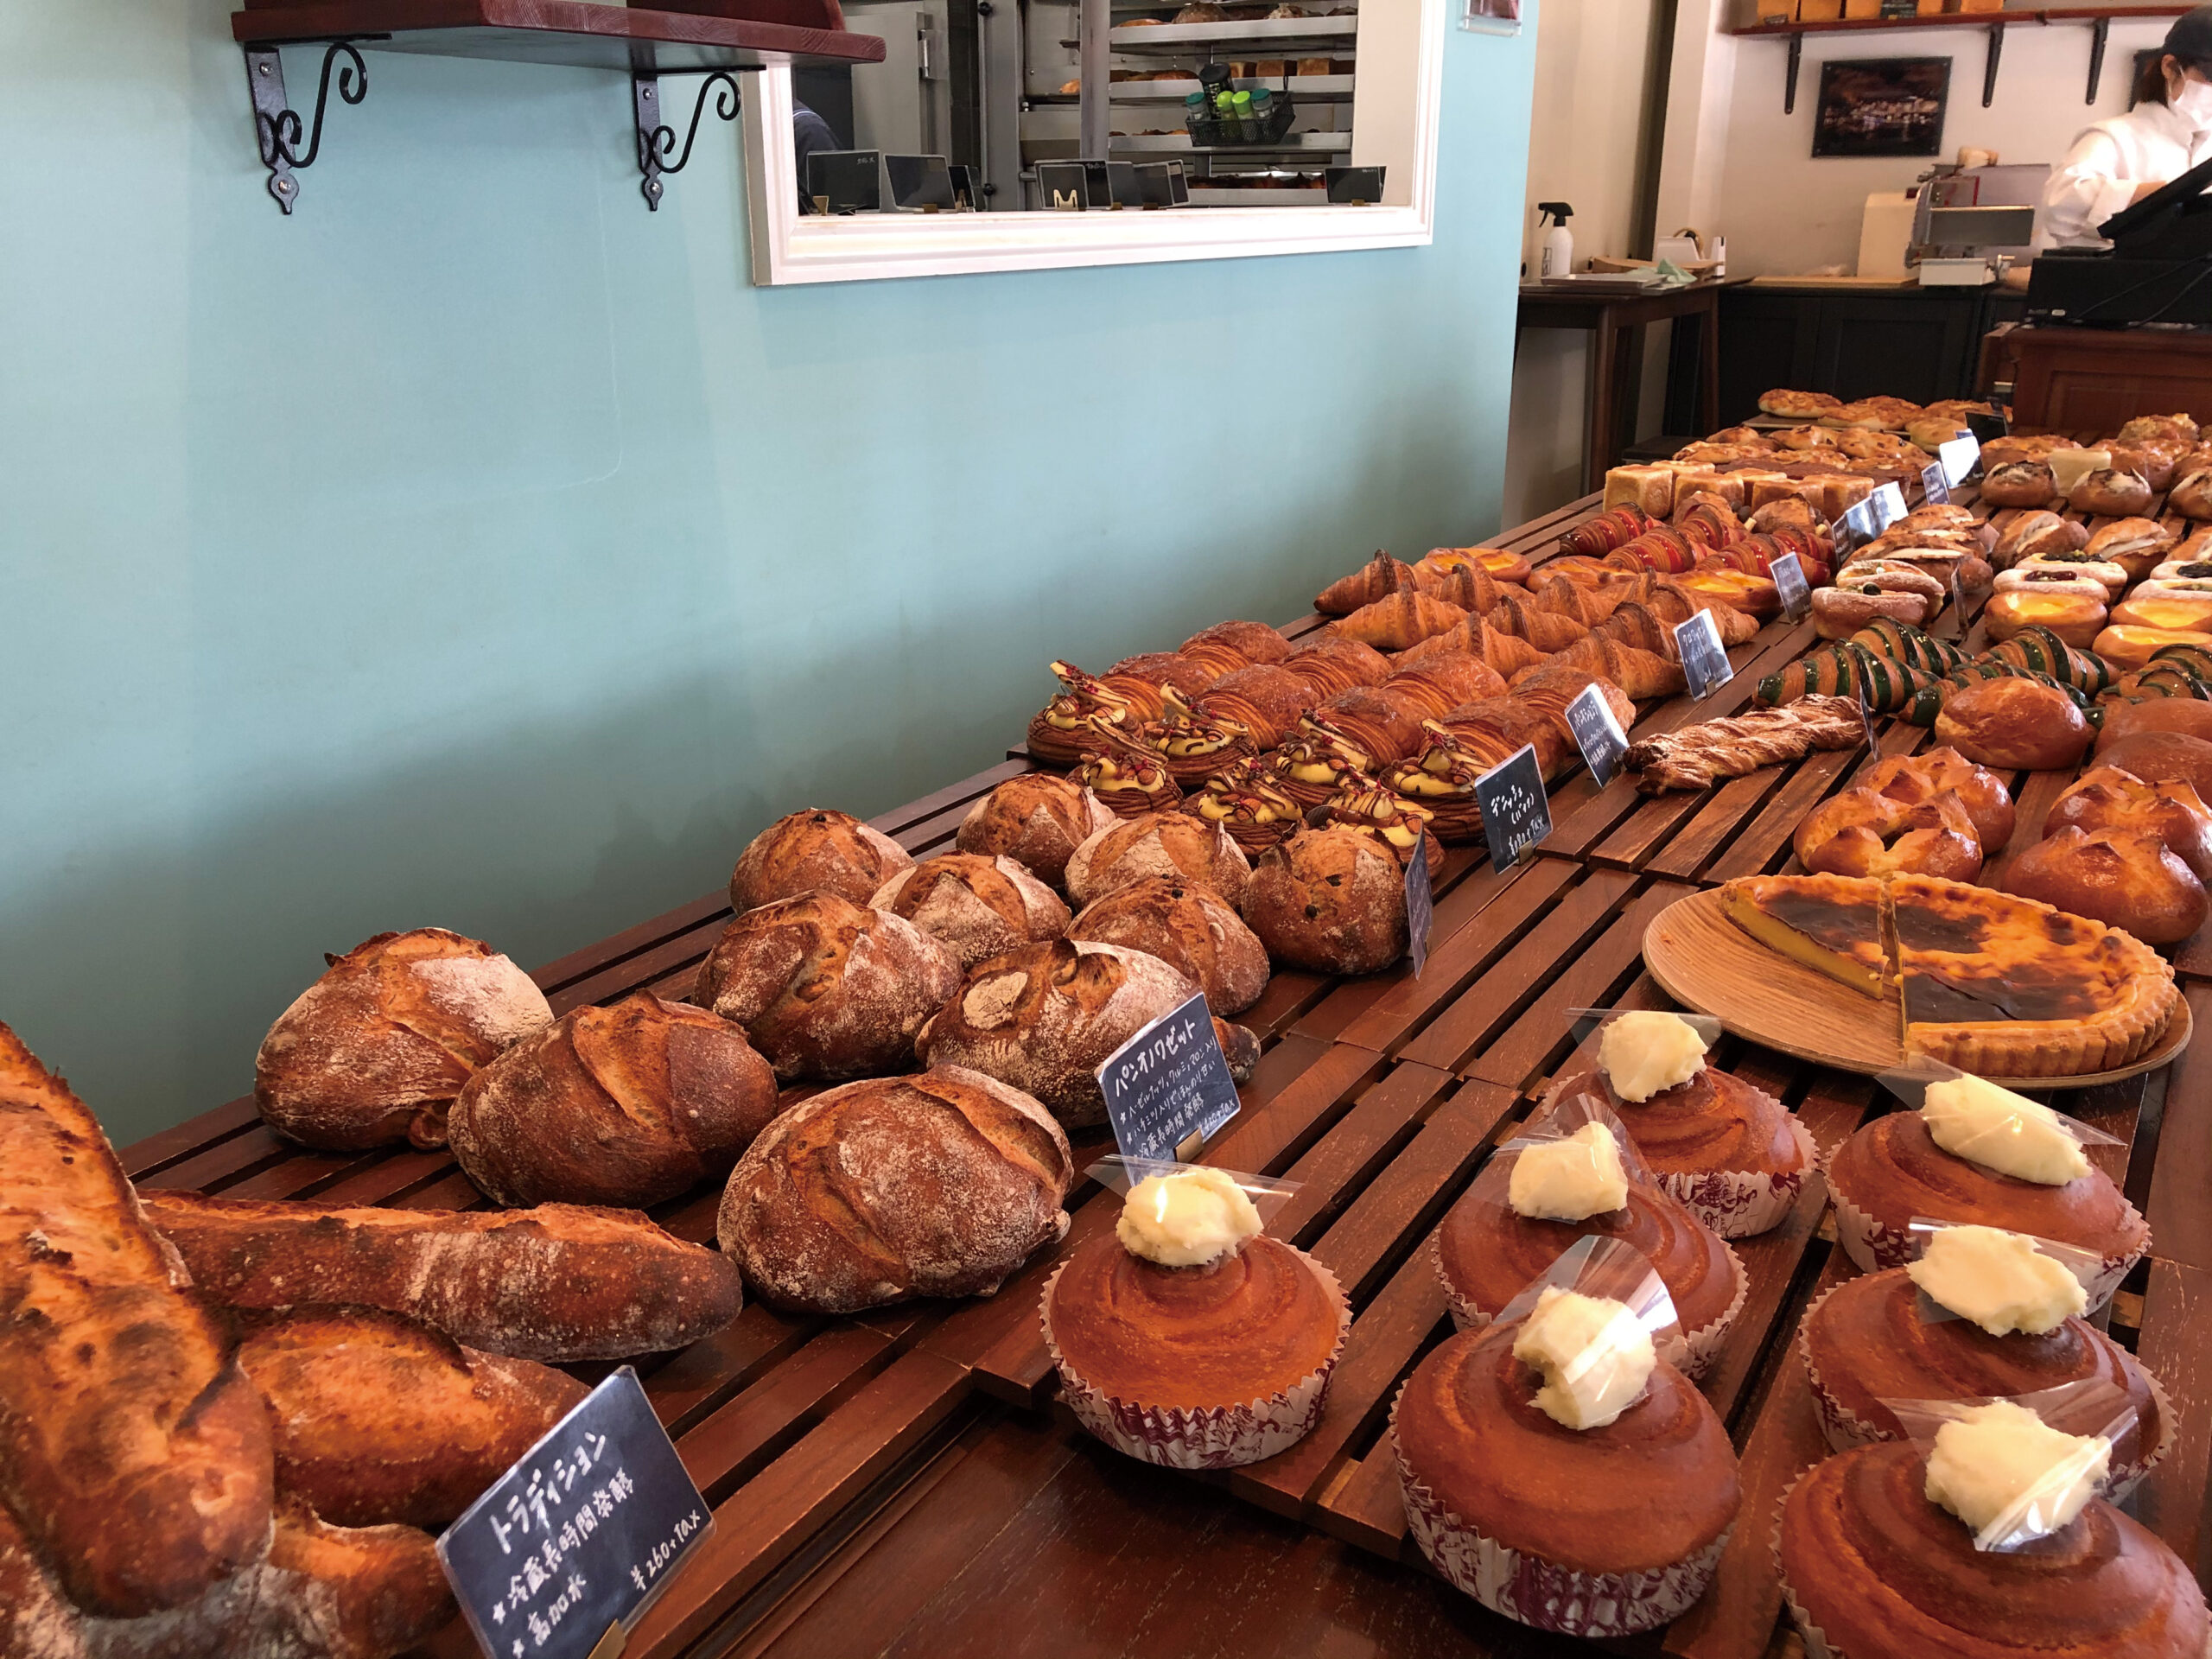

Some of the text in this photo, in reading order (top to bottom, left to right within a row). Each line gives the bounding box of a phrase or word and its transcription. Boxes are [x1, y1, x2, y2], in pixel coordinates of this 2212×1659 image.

[1116, 1018, 1196, 1097] パンオノワゼット
[490, 1431, 607, 1555] トラディション
[507, 1466, 634, 1611] 冷蔵長時間発酵
[528, 1573, 587, 1647] 高加水
